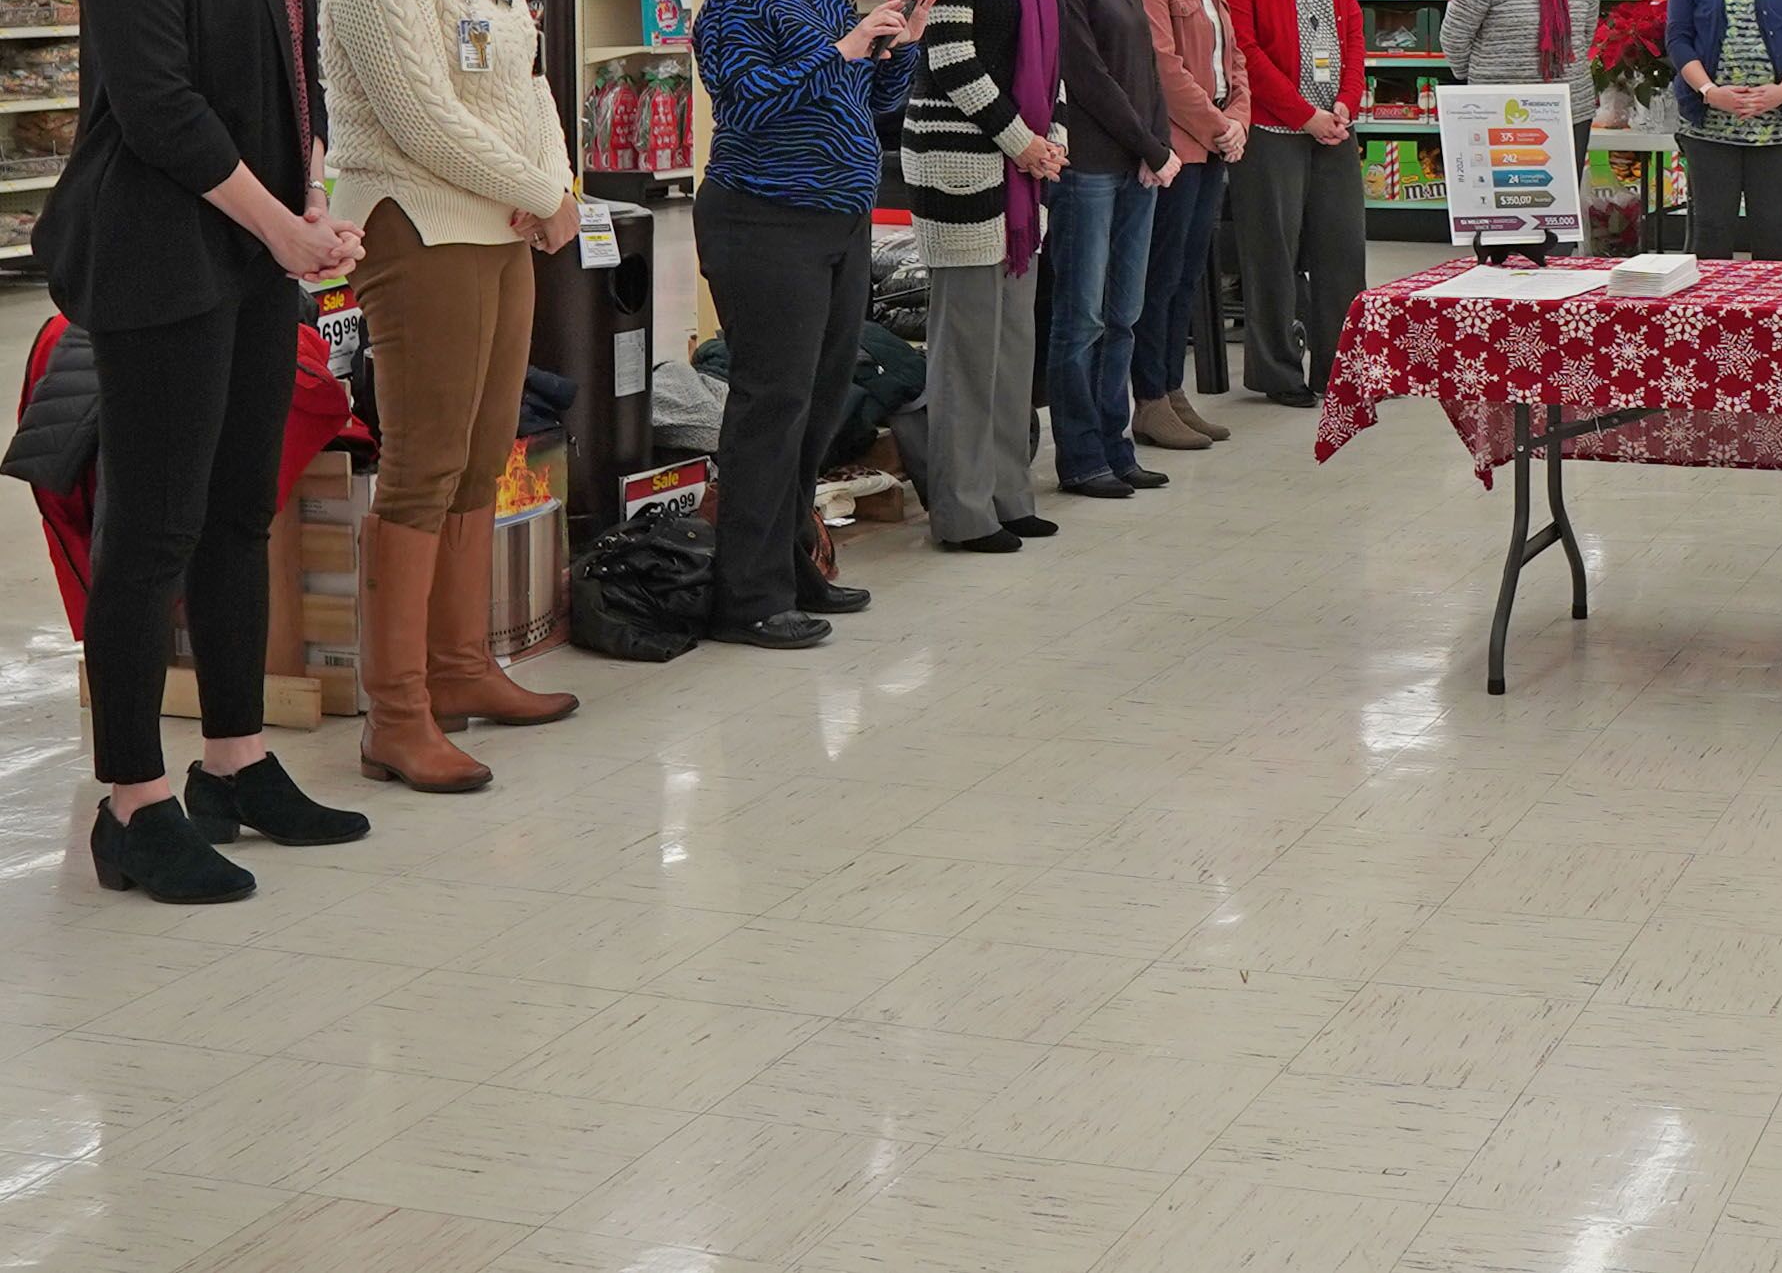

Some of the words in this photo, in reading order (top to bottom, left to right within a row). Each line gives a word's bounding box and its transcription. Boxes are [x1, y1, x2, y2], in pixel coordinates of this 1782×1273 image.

[1502, 153, 1518, 163] 242
[1508, 174, 1520, 184] 24
[323, 290, 345, 311] Sale
[652, 470, 680, 491] Sale
